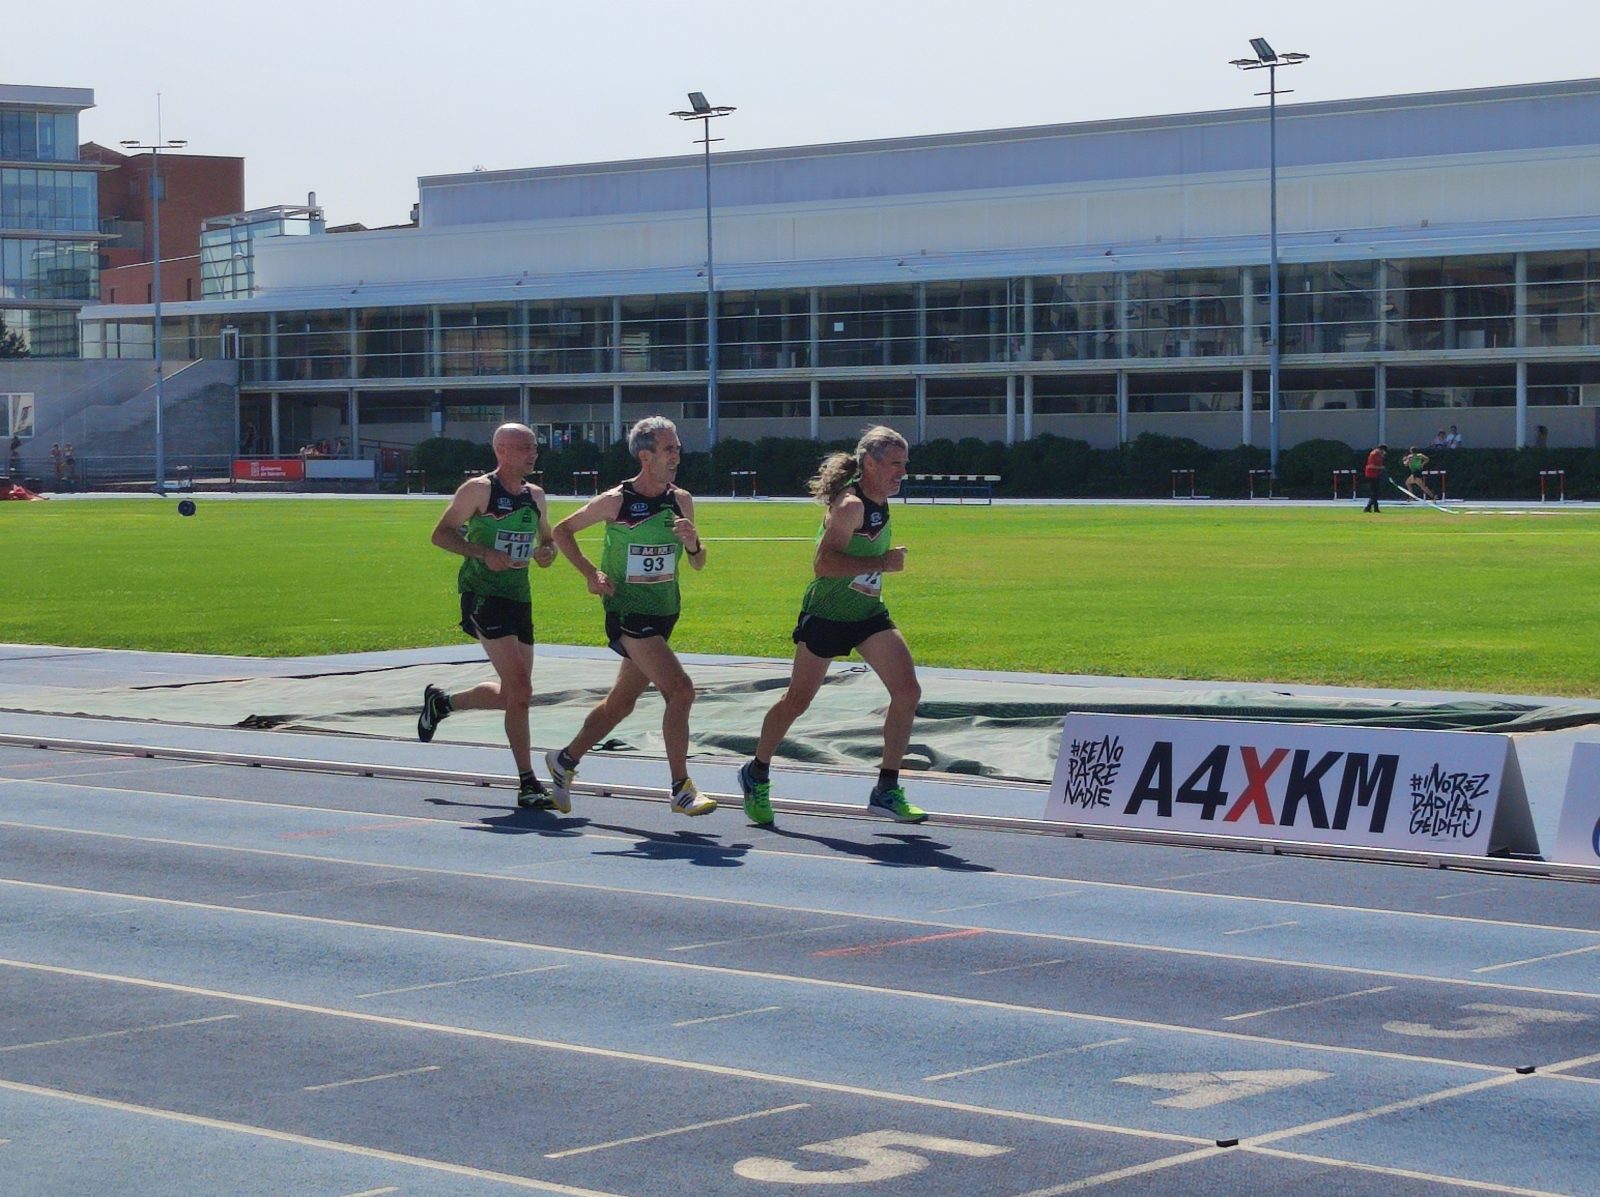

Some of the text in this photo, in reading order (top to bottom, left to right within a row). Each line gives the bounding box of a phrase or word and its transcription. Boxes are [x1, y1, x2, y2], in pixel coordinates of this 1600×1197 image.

[643, 557, 664, 572] 93
[1068, 756, 1121, 788] PARE
[1123, 741, 1400, 833] A4XKM
[1063, 779, 1112, 809] NADIE
[1410, 790, 1474, 821] DADILA
[1409, 809, 1482, 837] GELDITU
[733, 1129, 1015, 1184] 5
